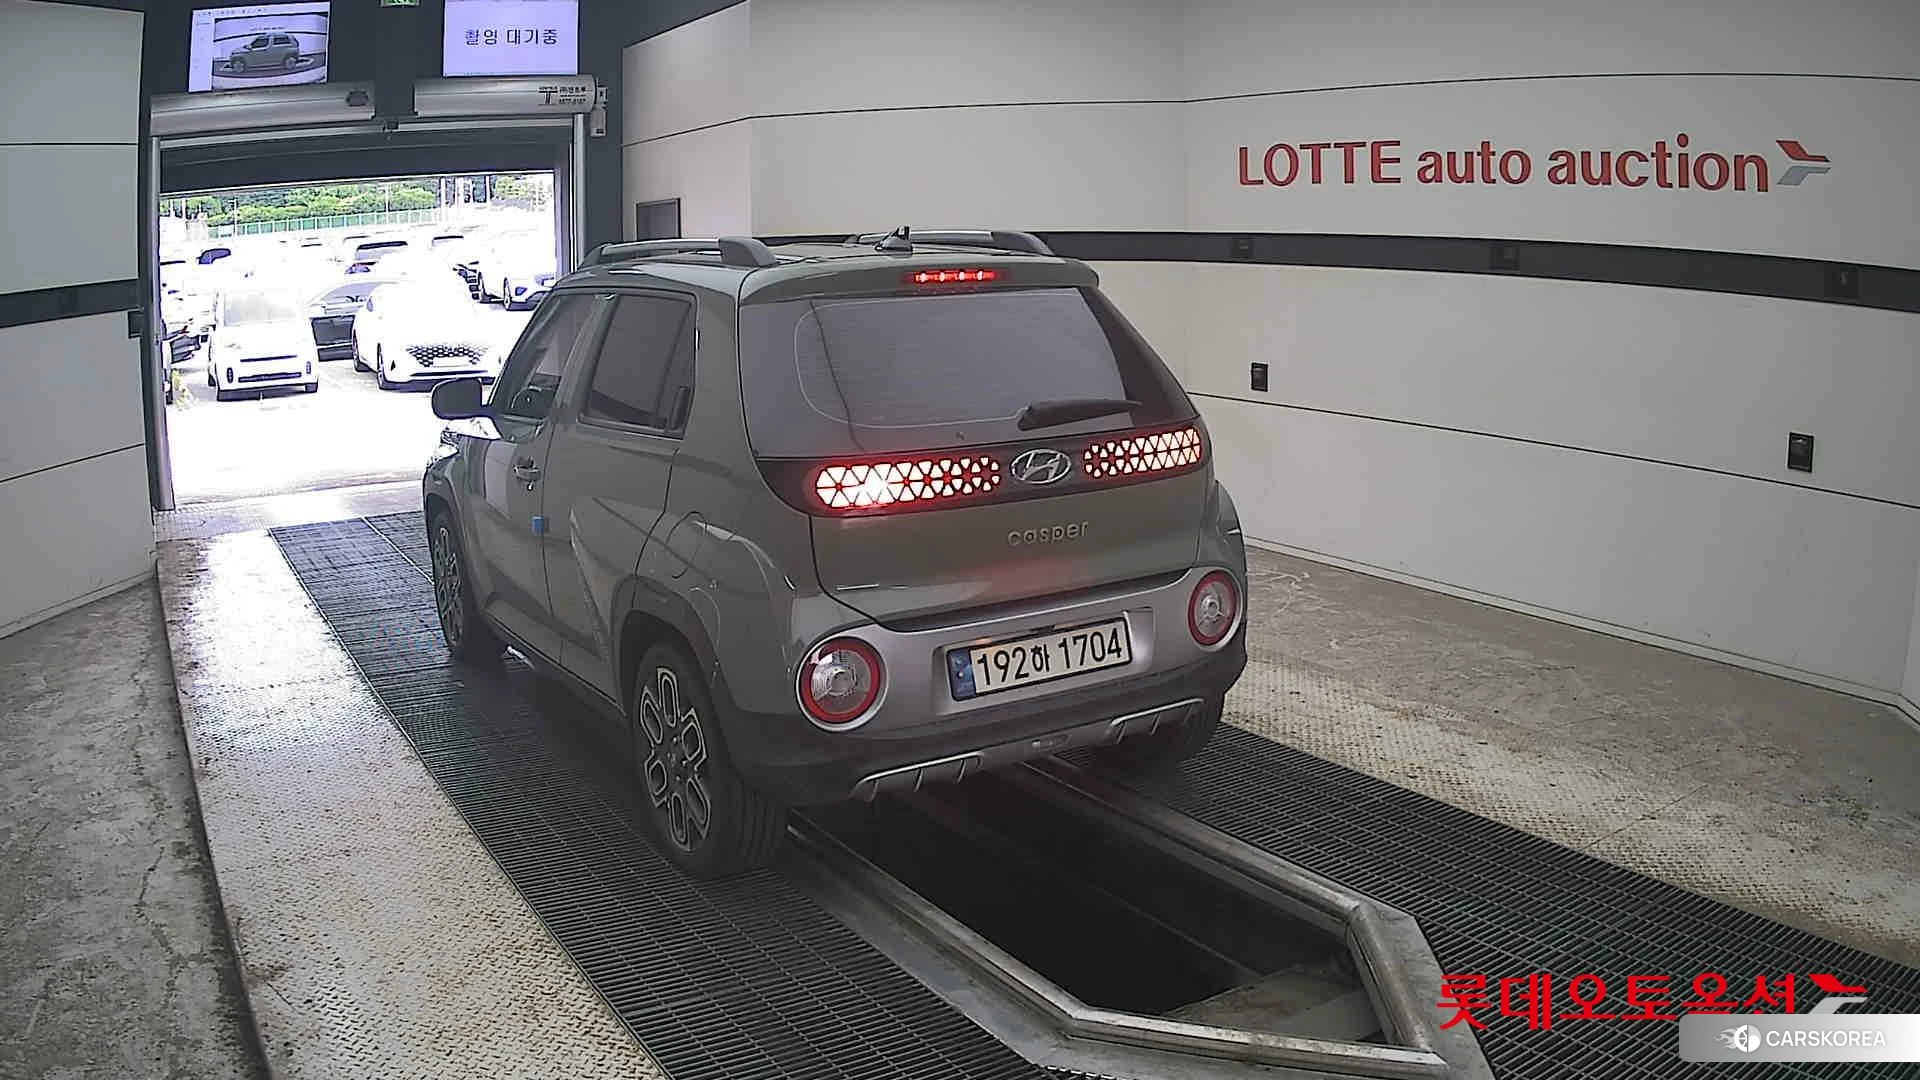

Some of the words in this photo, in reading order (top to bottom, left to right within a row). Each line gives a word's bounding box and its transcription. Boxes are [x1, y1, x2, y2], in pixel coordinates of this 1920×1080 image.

[506, 28, 559, 46] 대기중
[1239, 139, 1402, 186] LOTTE
[1416, 139, 1533, 186] auto
[1547, 133, 1770, 193] auction
[1007, 520, 1089, 546] casper
[976, 643, 1050, 686] 192하
[1058, 627, 1123, 670] 1704
